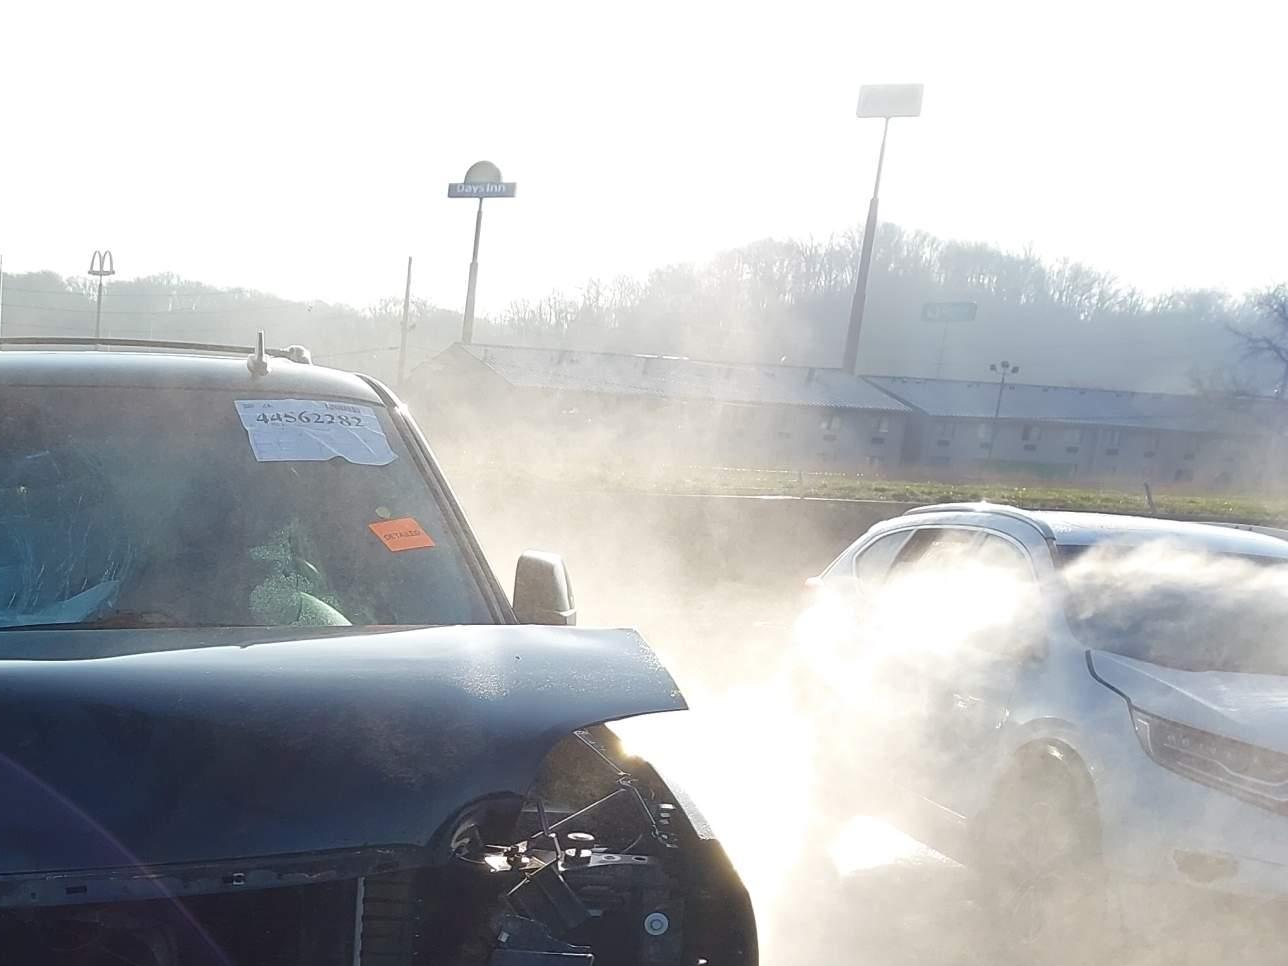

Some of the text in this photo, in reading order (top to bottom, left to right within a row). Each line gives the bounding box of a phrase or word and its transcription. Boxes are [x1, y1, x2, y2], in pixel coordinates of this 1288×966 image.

[456, 183, 506, 193] Days Inn
[256, 411, 364, 427] 44562282
